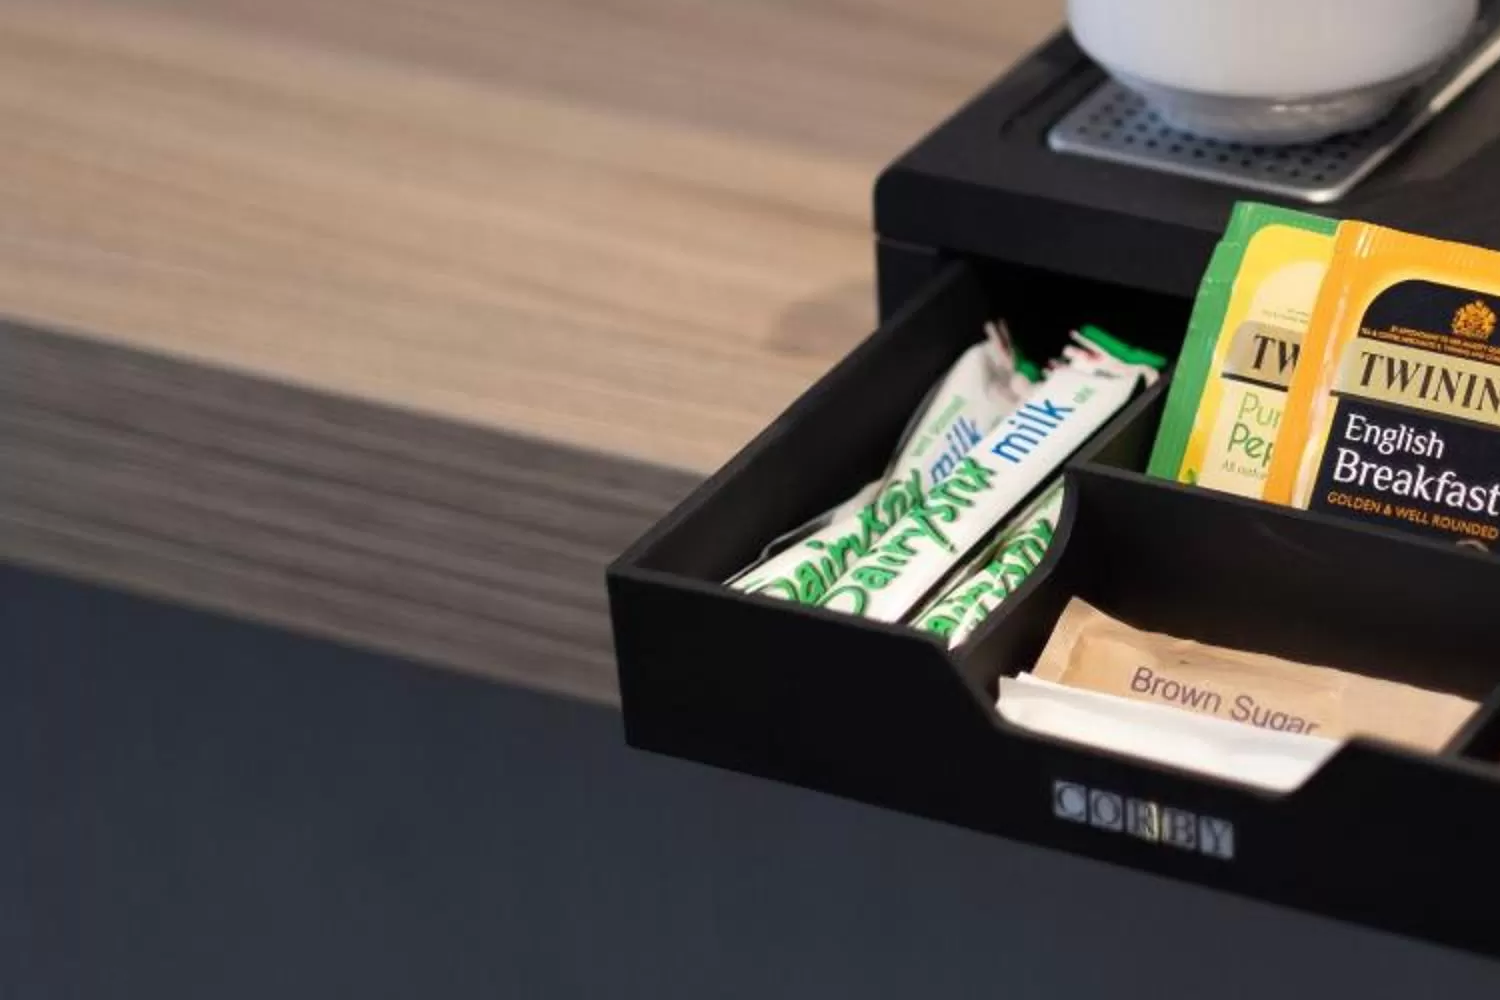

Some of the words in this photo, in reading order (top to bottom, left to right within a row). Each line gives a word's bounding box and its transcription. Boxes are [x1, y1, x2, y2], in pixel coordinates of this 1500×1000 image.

[930, 416, 982, 484] milk
[991, 399, 1075, 464] milk
[1345, 413, 1445, 459] English
[1327, 491, 1381, 514] GOLDEN
[1383, 503, 1393, 515] &
[1395, 507, 1429, 525] WELL
[1432, 515, 1499, 539] ROUNDED
[1131, 666, 1222, 712] Brown
[1230, 695, 1321, 735] Sugar
[1054, 780, 1235, 860] CORBY
